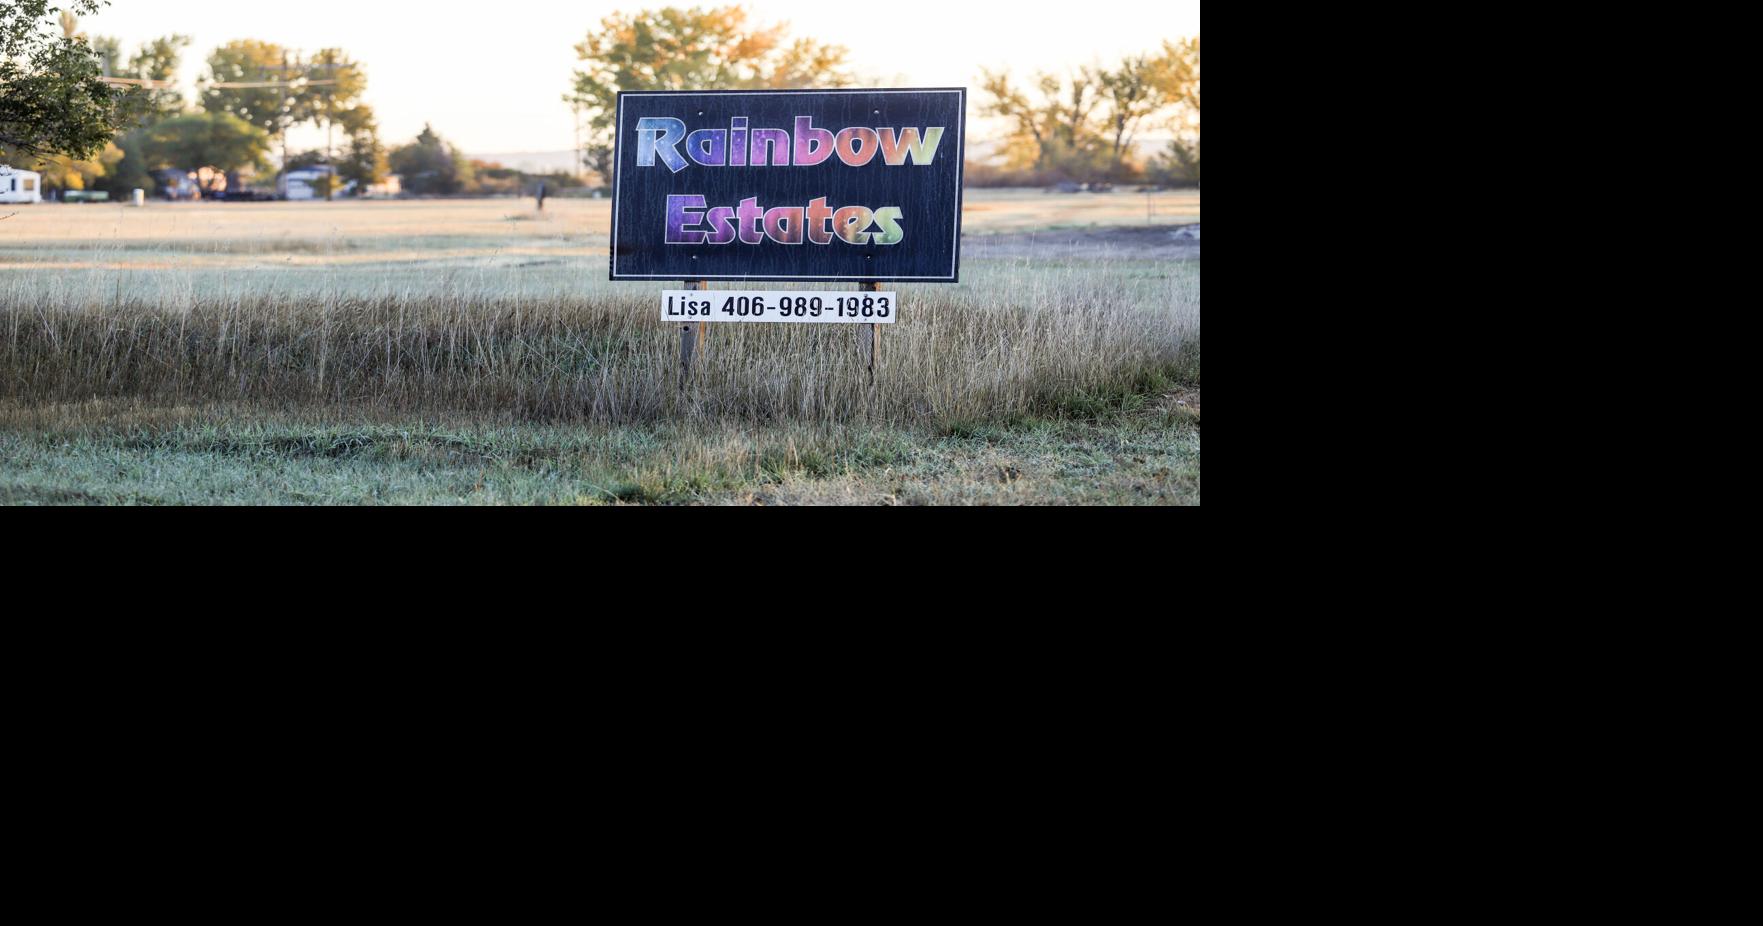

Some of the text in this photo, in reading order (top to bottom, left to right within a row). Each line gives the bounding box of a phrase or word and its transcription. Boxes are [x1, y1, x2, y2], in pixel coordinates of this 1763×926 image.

[636, 116, 945, 174] Rainbow
[665, 194, 904, 245] Estates
[668, 296, 890, 318] Lisa 406-989-1983
